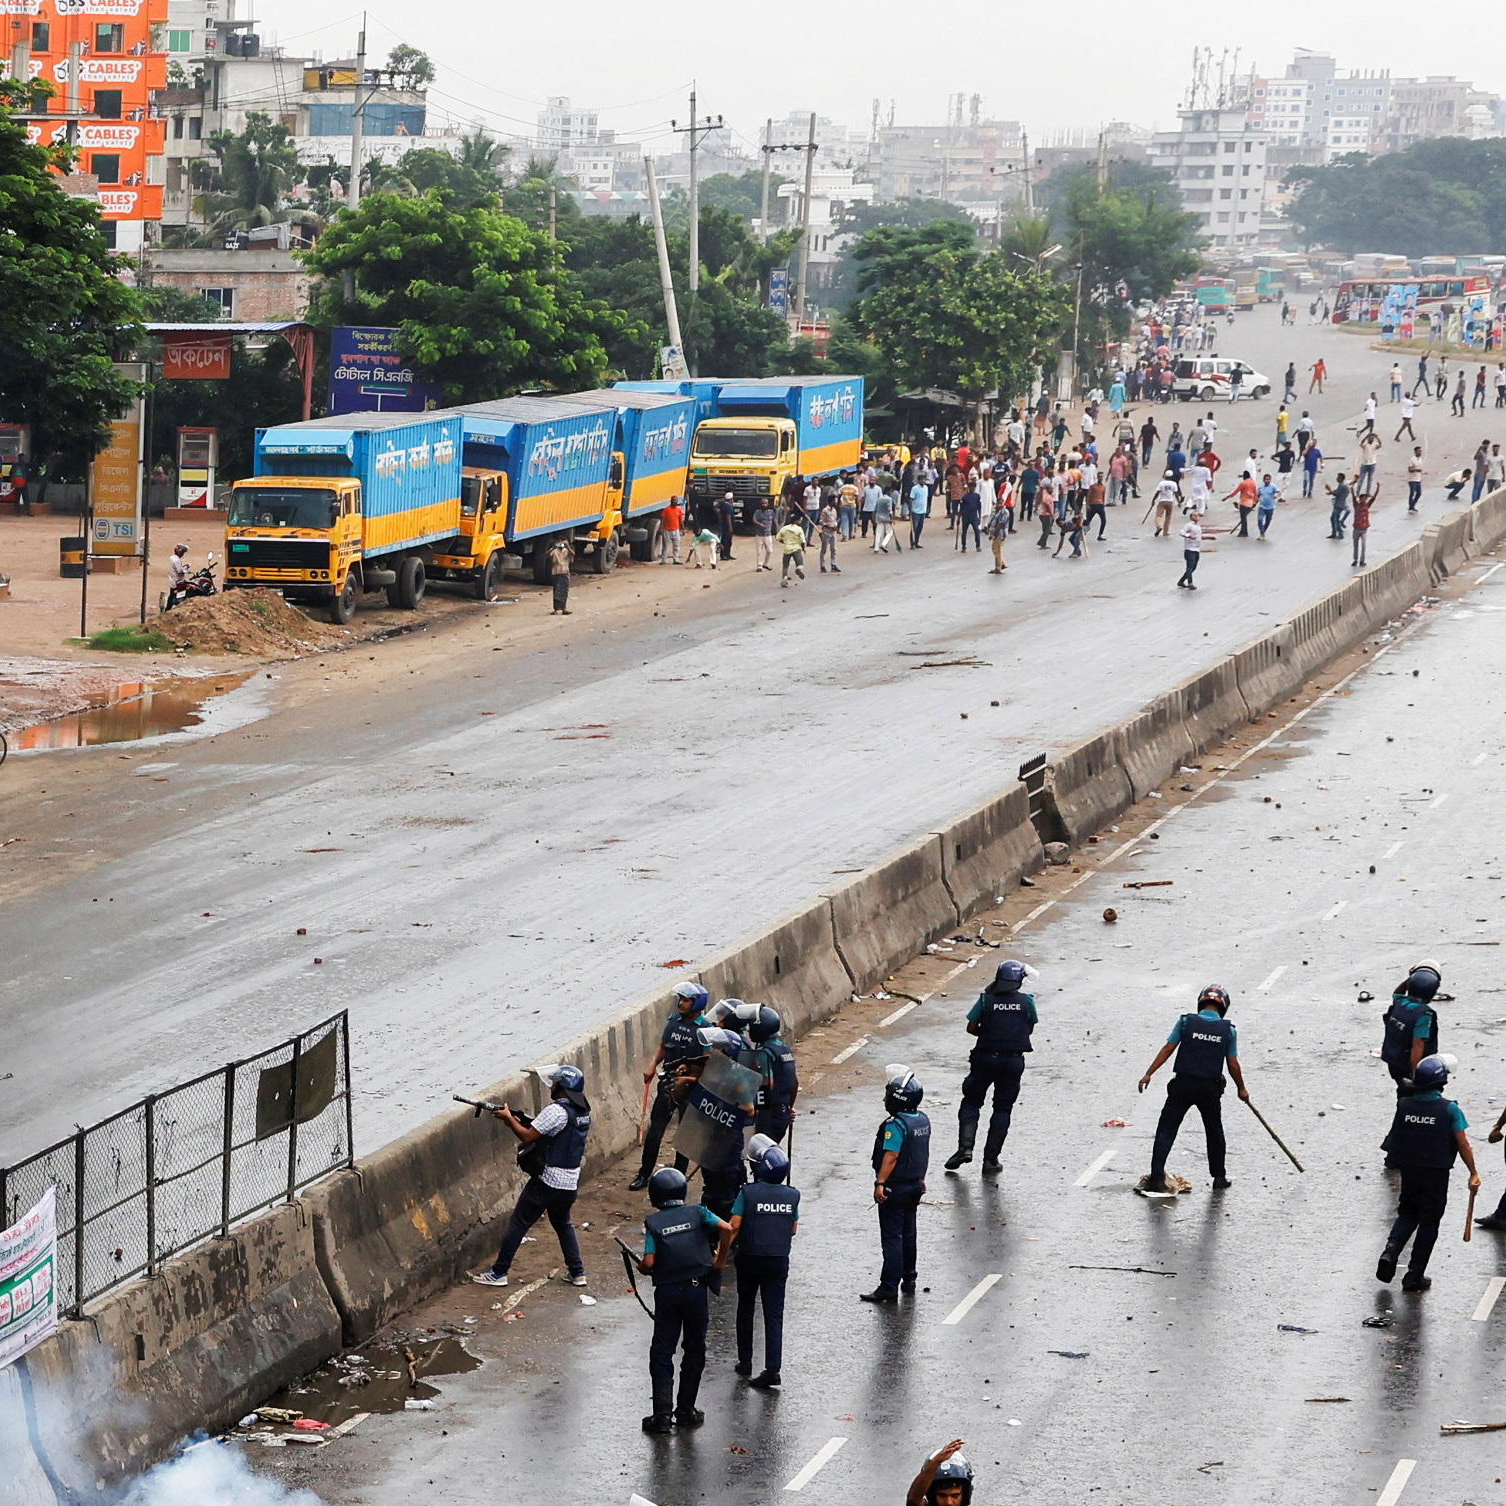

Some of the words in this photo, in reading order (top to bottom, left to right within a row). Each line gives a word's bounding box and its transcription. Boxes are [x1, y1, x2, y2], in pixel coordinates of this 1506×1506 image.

[88, 63, 135, 74] CABLES
[85, 129, 132, 140] CABLES
[102, 194, 131, 205] BLES
[168, 345, 225, 369] অকটেন
[334, 367, 369, 381] টোটাল
[373, 368, 414, 385] সিএনজি
[113, 524, 133, 536] TSI
[993, 1003, 1022, 1011] POLICE
[1192, 1032, 1223, 1043] POLICE
[893, 1093, 908, 1102] POLICE
[699, 1098, 737, 1128] POLICE
[1405, 1114, 1436, 1125] POLICE
[914, 1127, 930, 1137] POLICE
[757, 1203, 792, 1213] POLICE
